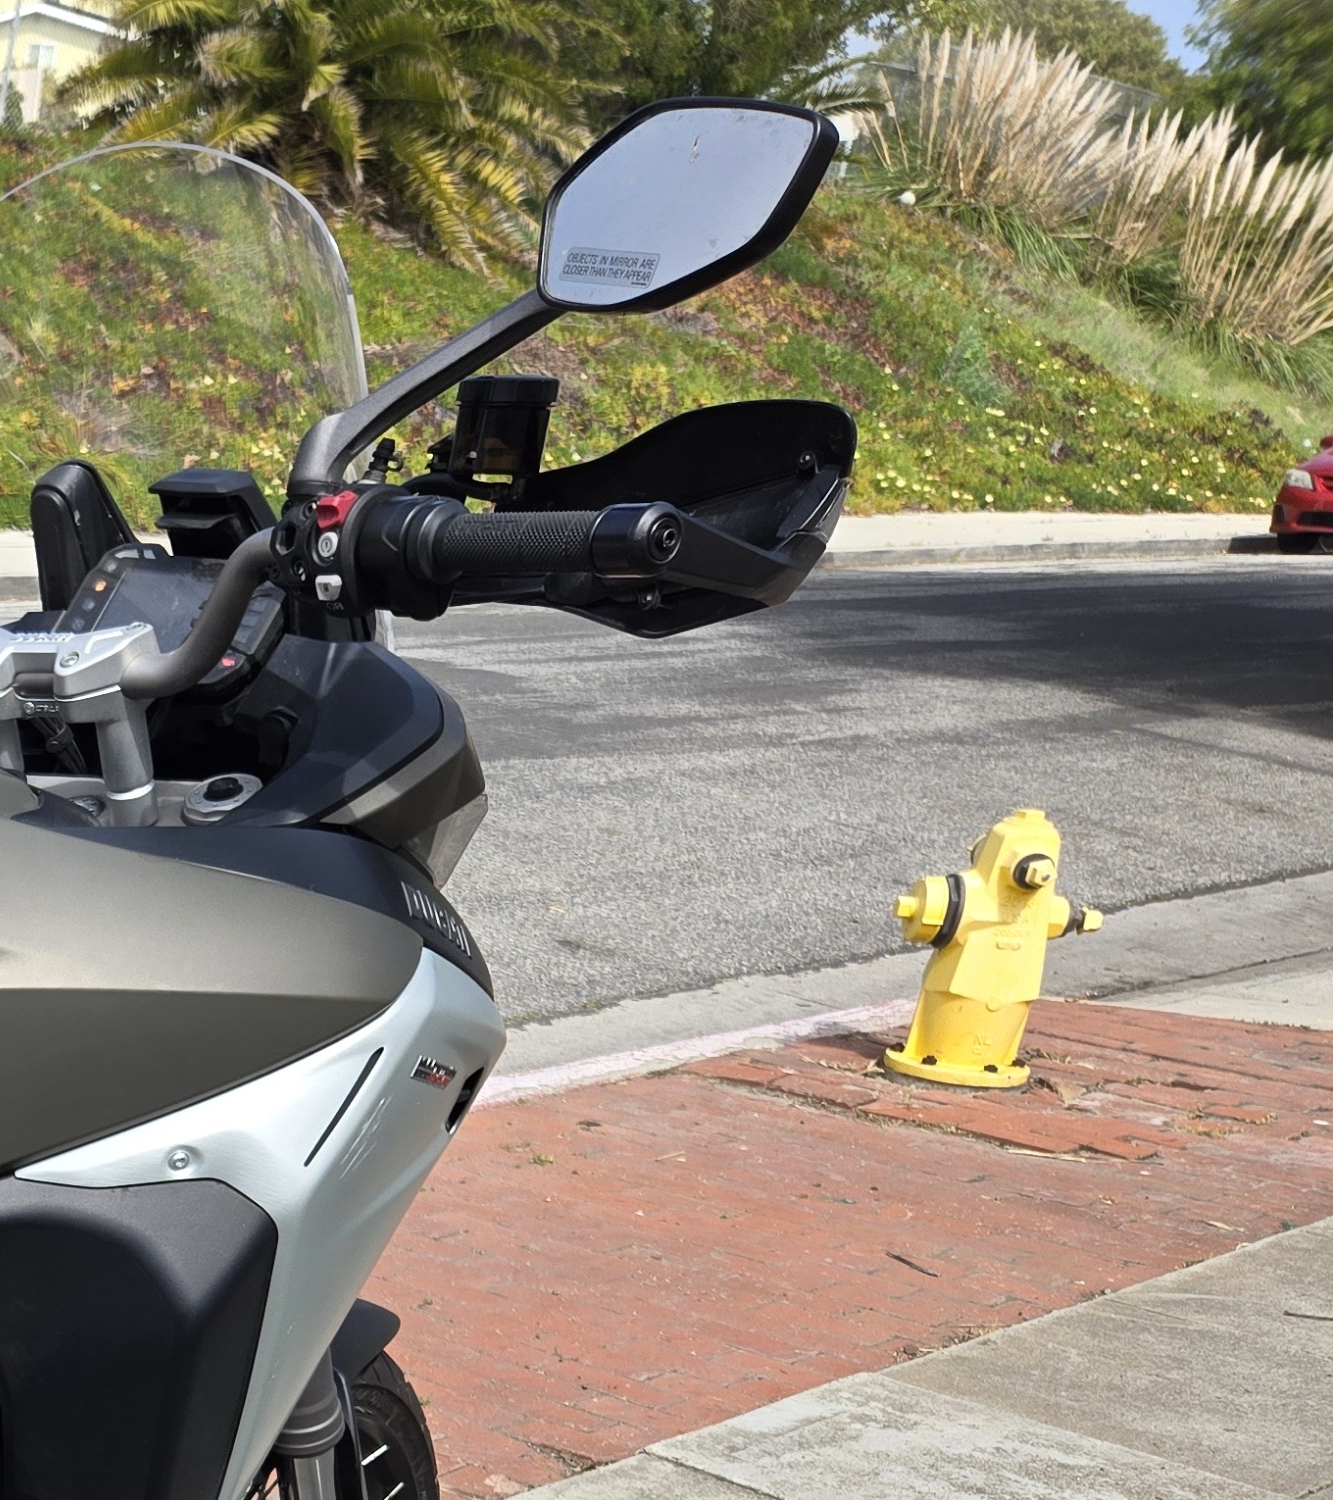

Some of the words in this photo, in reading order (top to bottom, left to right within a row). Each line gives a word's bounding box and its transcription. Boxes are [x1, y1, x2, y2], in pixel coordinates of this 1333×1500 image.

[567, 253, 598, 266] OBJECTS
[599, 255, 608, 266] IN
[608, 256, 639, 268] MIRROR
[639, 259, 656, 270] ARE
[562, 264, 590, 276] CLOSER
[589, 266, 608, 278] THAN
[607, 267, 625, 279] THEY
[623, 270, 652, 282] APPEAR
